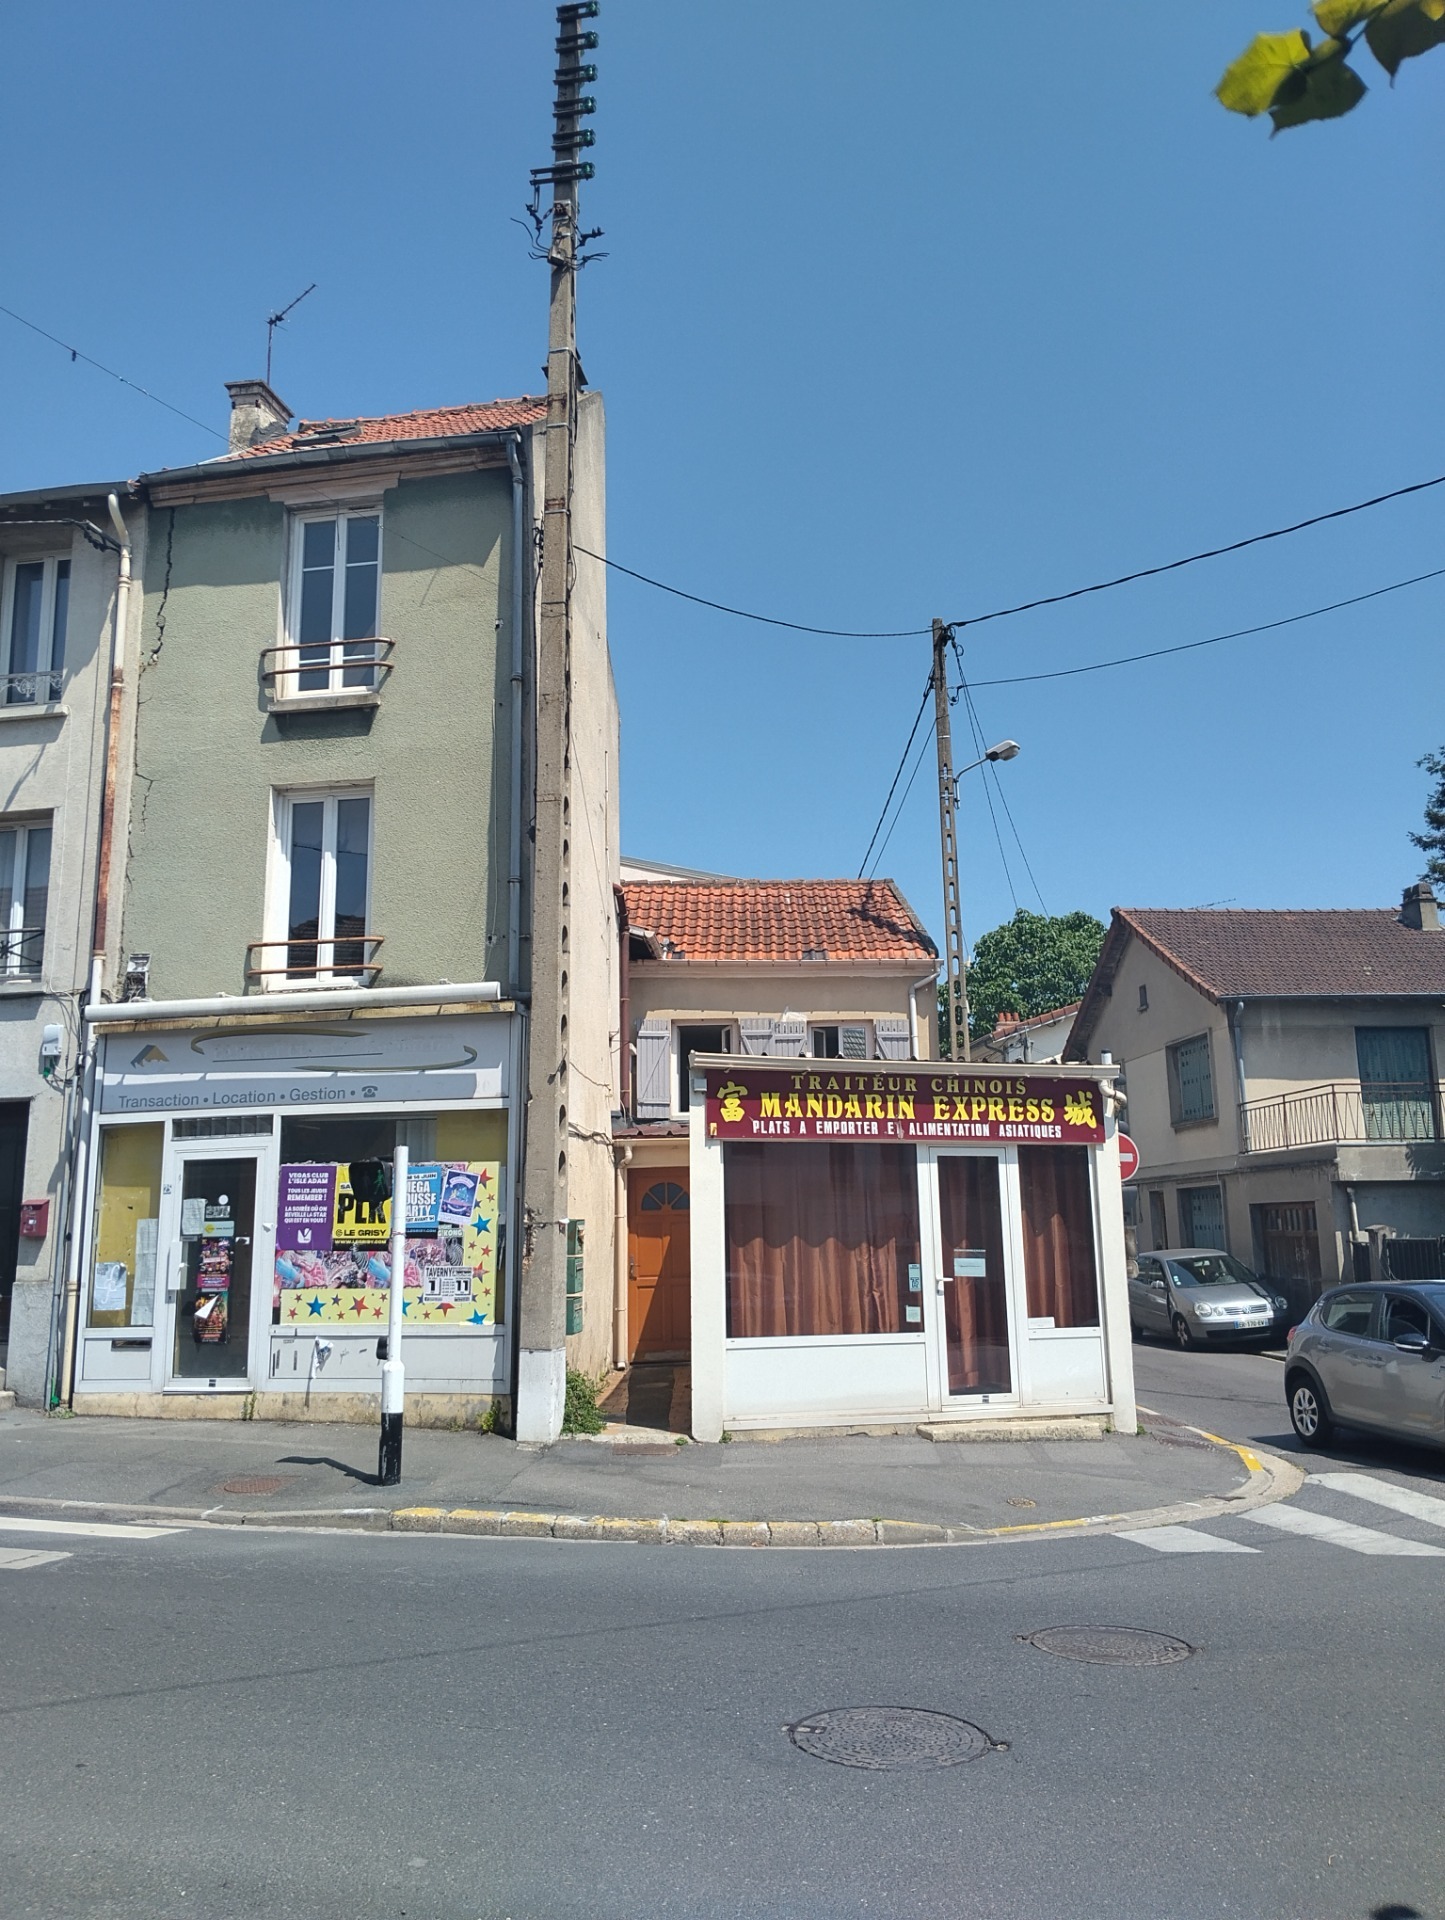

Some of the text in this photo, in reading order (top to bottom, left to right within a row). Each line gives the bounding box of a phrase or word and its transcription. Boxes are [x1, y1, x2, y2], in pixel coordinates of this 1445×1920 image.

[791, 1075, 1027, 1095] TRAITEUR CHINOIS
[118, 1087, 346, 1109] Transaction Location Gestion
[716, 1081, 748, 1122] 富
[759, 1092, 1055, 1123] MANDARIN EXPRESS
[1063, 1090, 1097, 1129] 城
[752, 1120, 790, 1135] PLATS
[799, 1121, 807, 1135] A
[816, 1120, 879, 1136] EMPORTER
[909, 1122, 990, 1137] ALIMENTATION
[999, 1124, 1062, 1139] ASIATIQUES
[406, 1205, 432, 1217] ARTY
[344, 1229, 387, 1237] LE GRISY
[426, 1267, 452, 1277] TAVERNY
